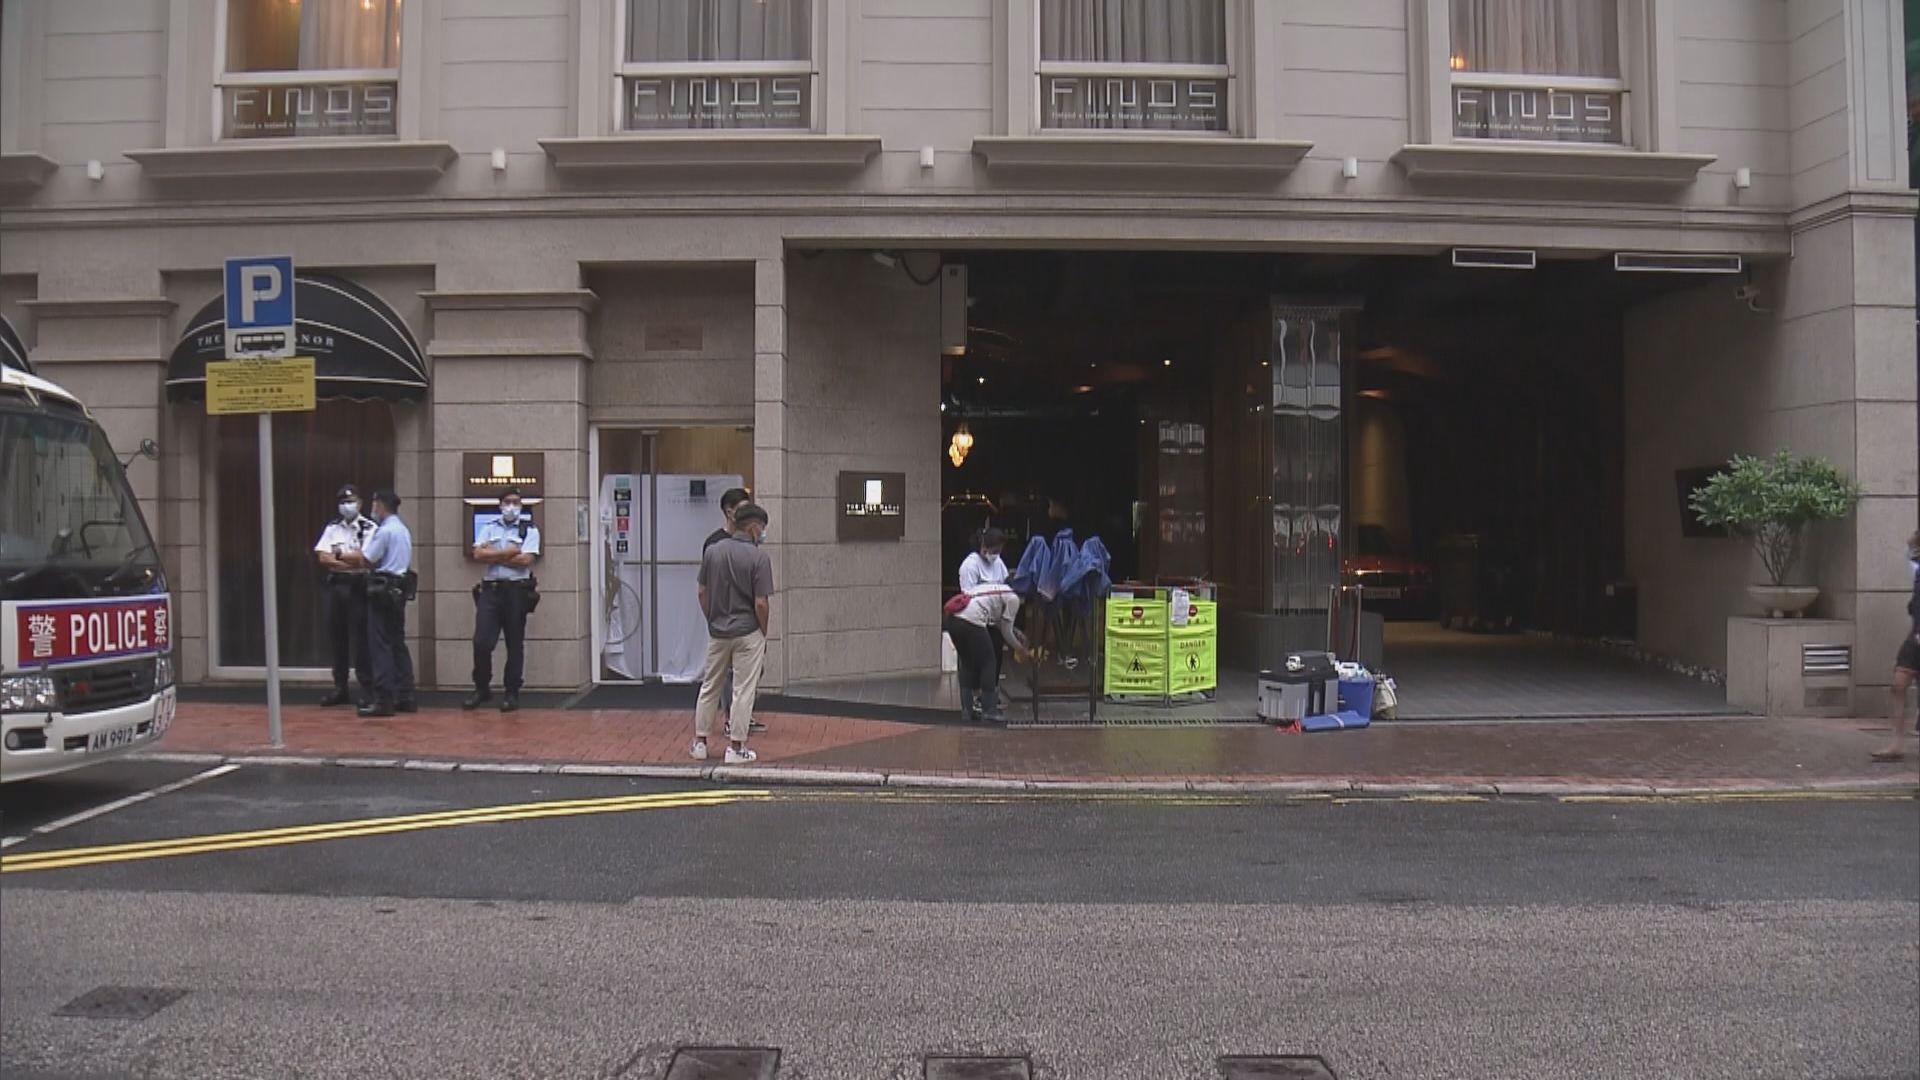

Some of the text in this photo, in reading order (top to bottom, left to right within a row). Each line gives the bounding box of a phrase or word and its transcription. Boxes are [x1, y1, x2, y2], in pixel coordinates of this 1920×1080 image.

[240, 265, 282, 323] P
[197, 335, 221, 347] THE
[28, 606, 167, 657] 警 POLICE 察
[1180, 640, 1207, 649] DANGER
[92, 727, 133, 750] AM 9912
